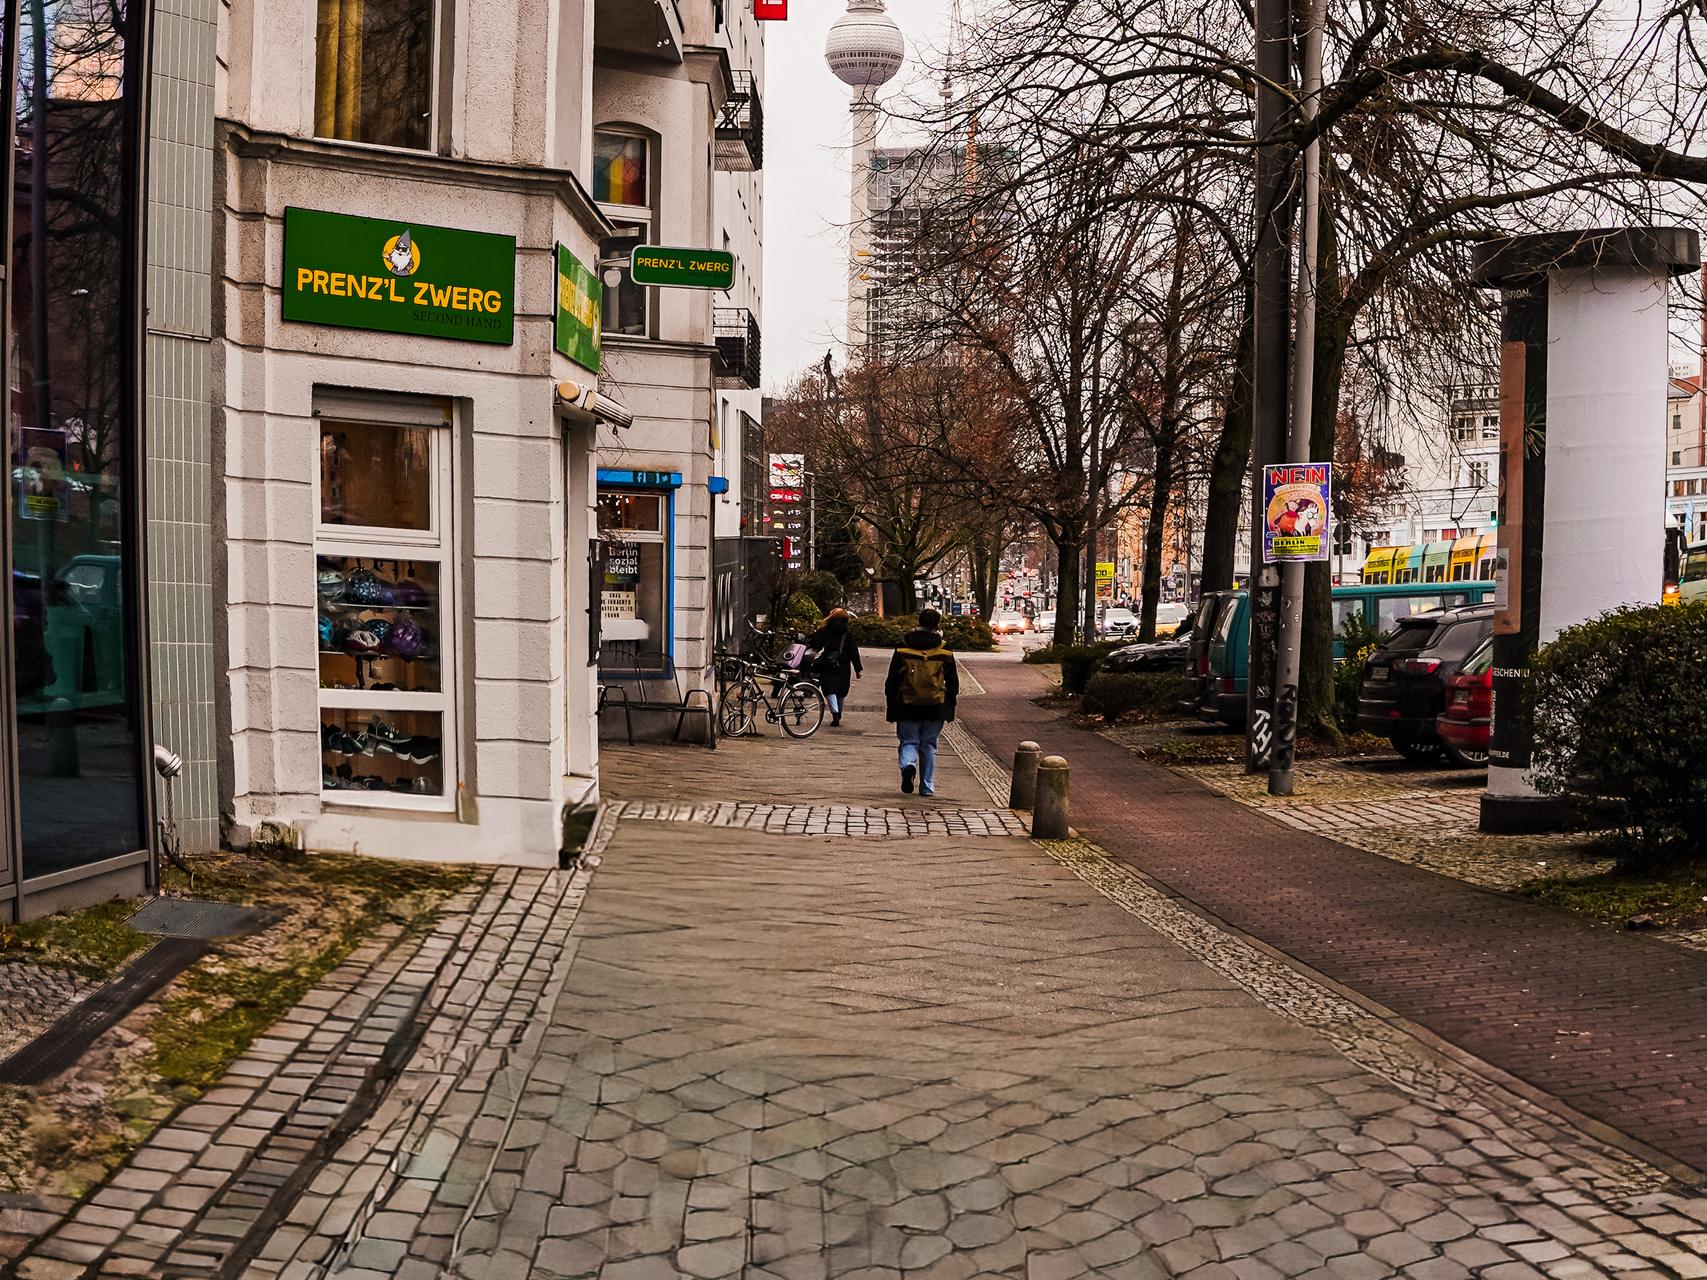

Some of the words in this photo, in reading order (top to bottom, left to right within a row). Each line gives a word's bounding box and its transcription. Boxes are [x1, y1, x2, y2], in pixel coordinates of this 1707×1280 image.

[637, 257, 685, 270] PRENZ'L
[688, 260, 730, 273] ZWERG
[297, 267, 405, 303] PRENZ'L
[413, 281, 503, 314] ZWERG
[412, 309, 463, 327] SECOND
[465, 315, 503, 330] HAND
[1270, 468, 1325, 485] NEIN
[609, 547, 638, 556] Berlin
[609, 556, 638, 565] sozial
[609, 565, 638, 574] bleibt
